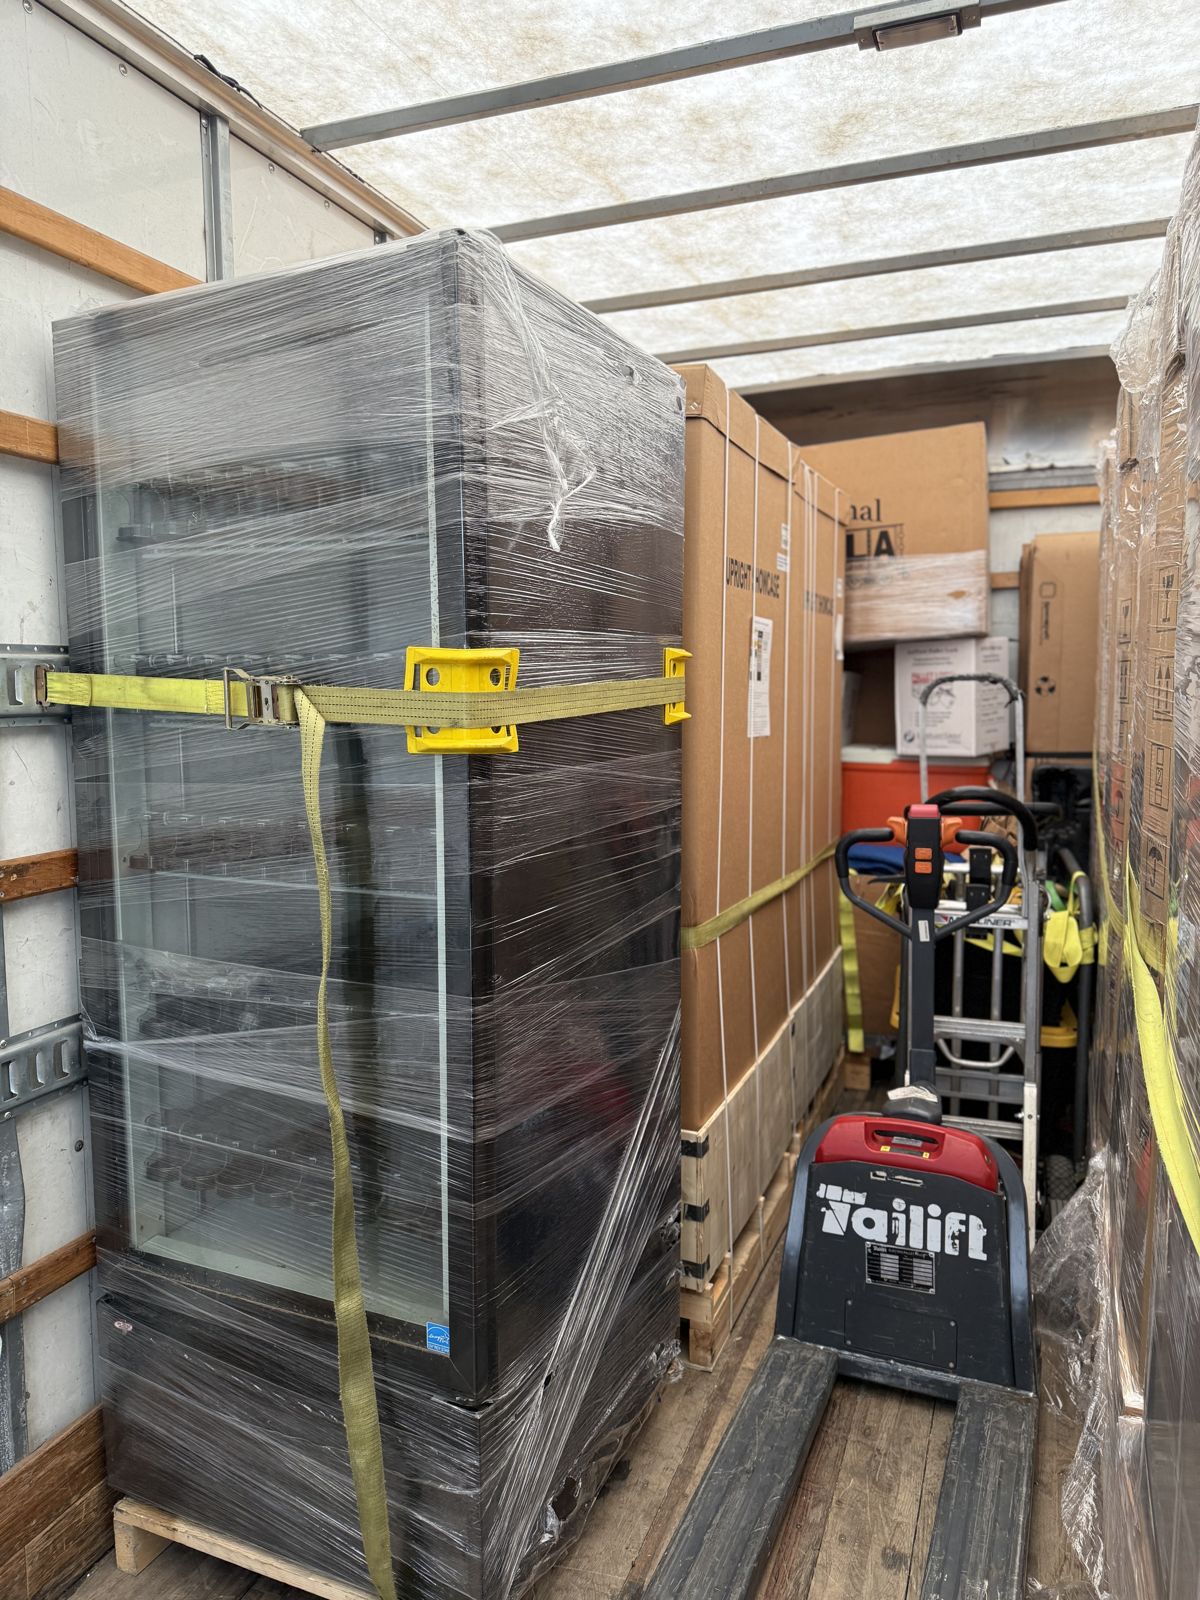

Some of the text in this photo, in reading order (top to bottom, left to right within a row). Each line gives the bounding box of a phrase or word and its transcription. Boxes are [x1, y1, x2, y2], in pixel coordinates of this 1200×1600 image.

[726, 557, 752, 591] UPRIGHT
[752, 567, 780, 599] HOWCASE
[816, 1183, 988, 1261] Tailift
